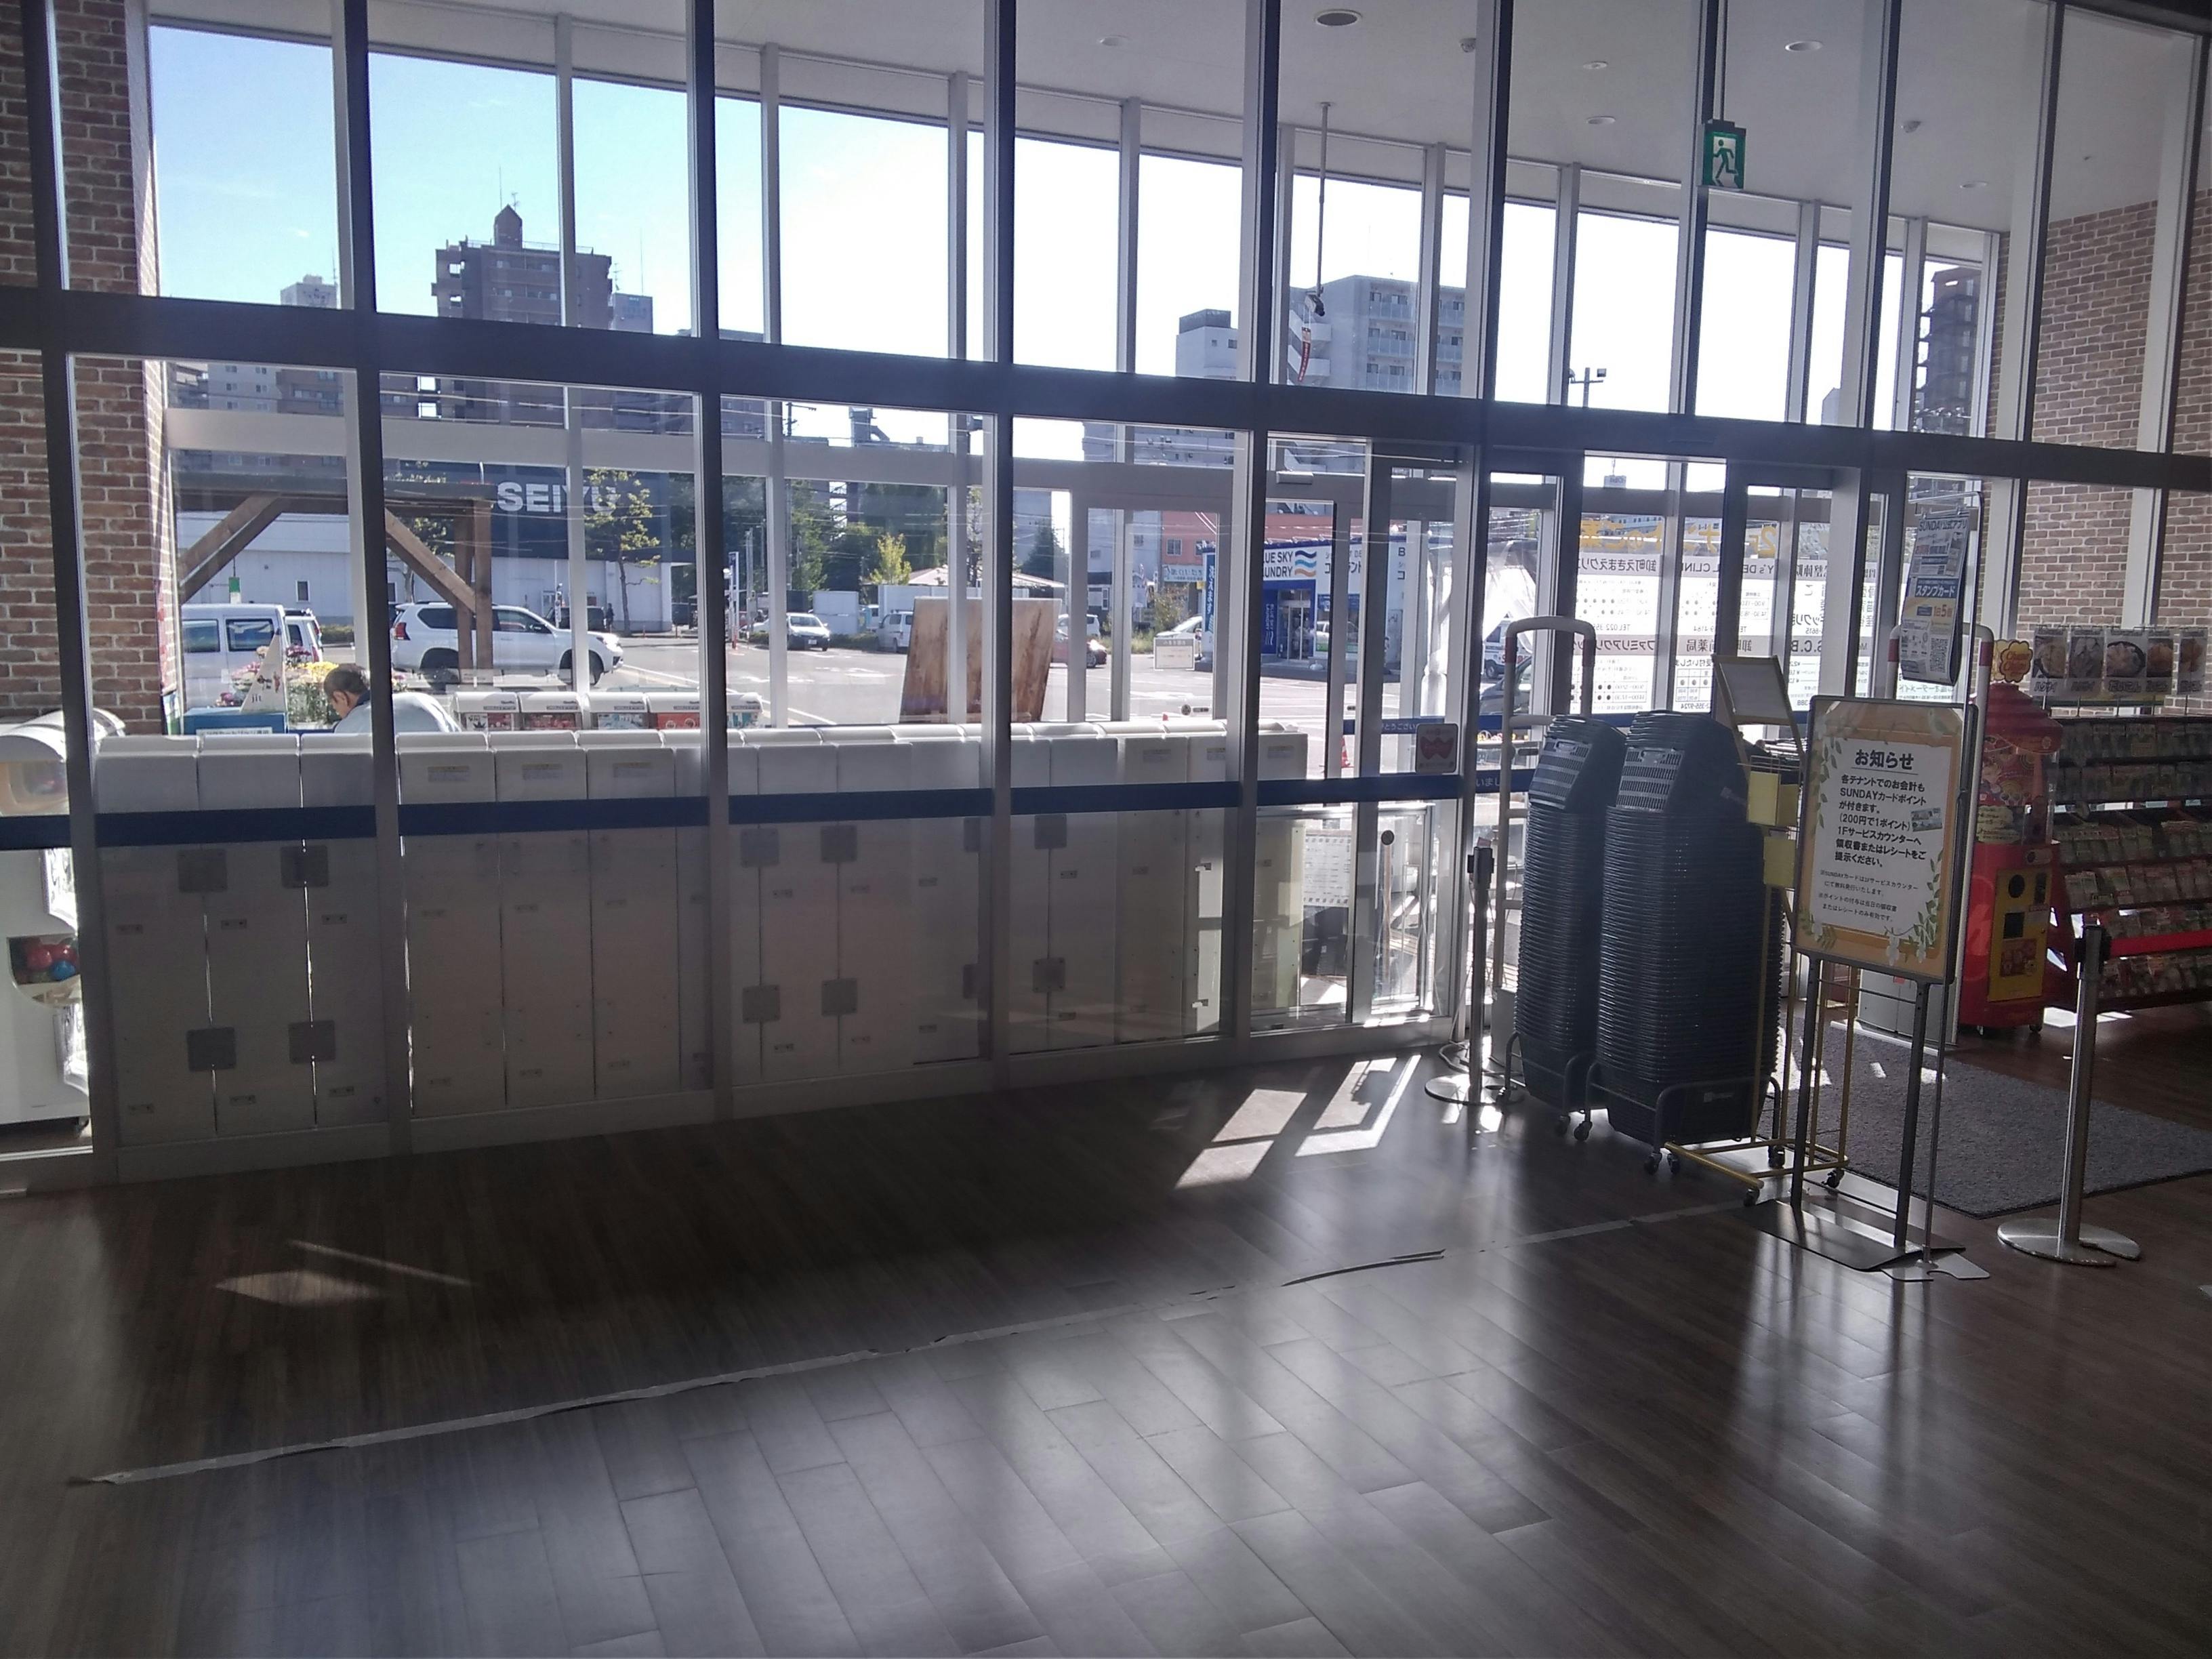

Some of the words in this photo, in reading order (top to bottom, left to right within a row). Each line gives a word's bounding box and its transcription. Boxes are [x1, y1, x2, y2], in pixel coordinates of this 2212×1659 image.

[1277, 552, 1293, 564] SKY
[1916, 584, 1955, 597] スタンプカード
[1855, 749, 1914, 770] お知らせ
[1841, 774, 1926, 792] 各テナントでのお会計も
[1840, 787, 1927, 806] SUNDAYカードポイント
[1839, 800, 1880, 814] が付きます。
[1839, 813, 1910, 832] (200円で1ポイント)
[1838, 825, 1922, 846] 1Fサービスカウンターへ
[1836, 838, 1927, 860] 領収書またはレシートをご
[1835, 851, 1883, 867] 提示ください。
